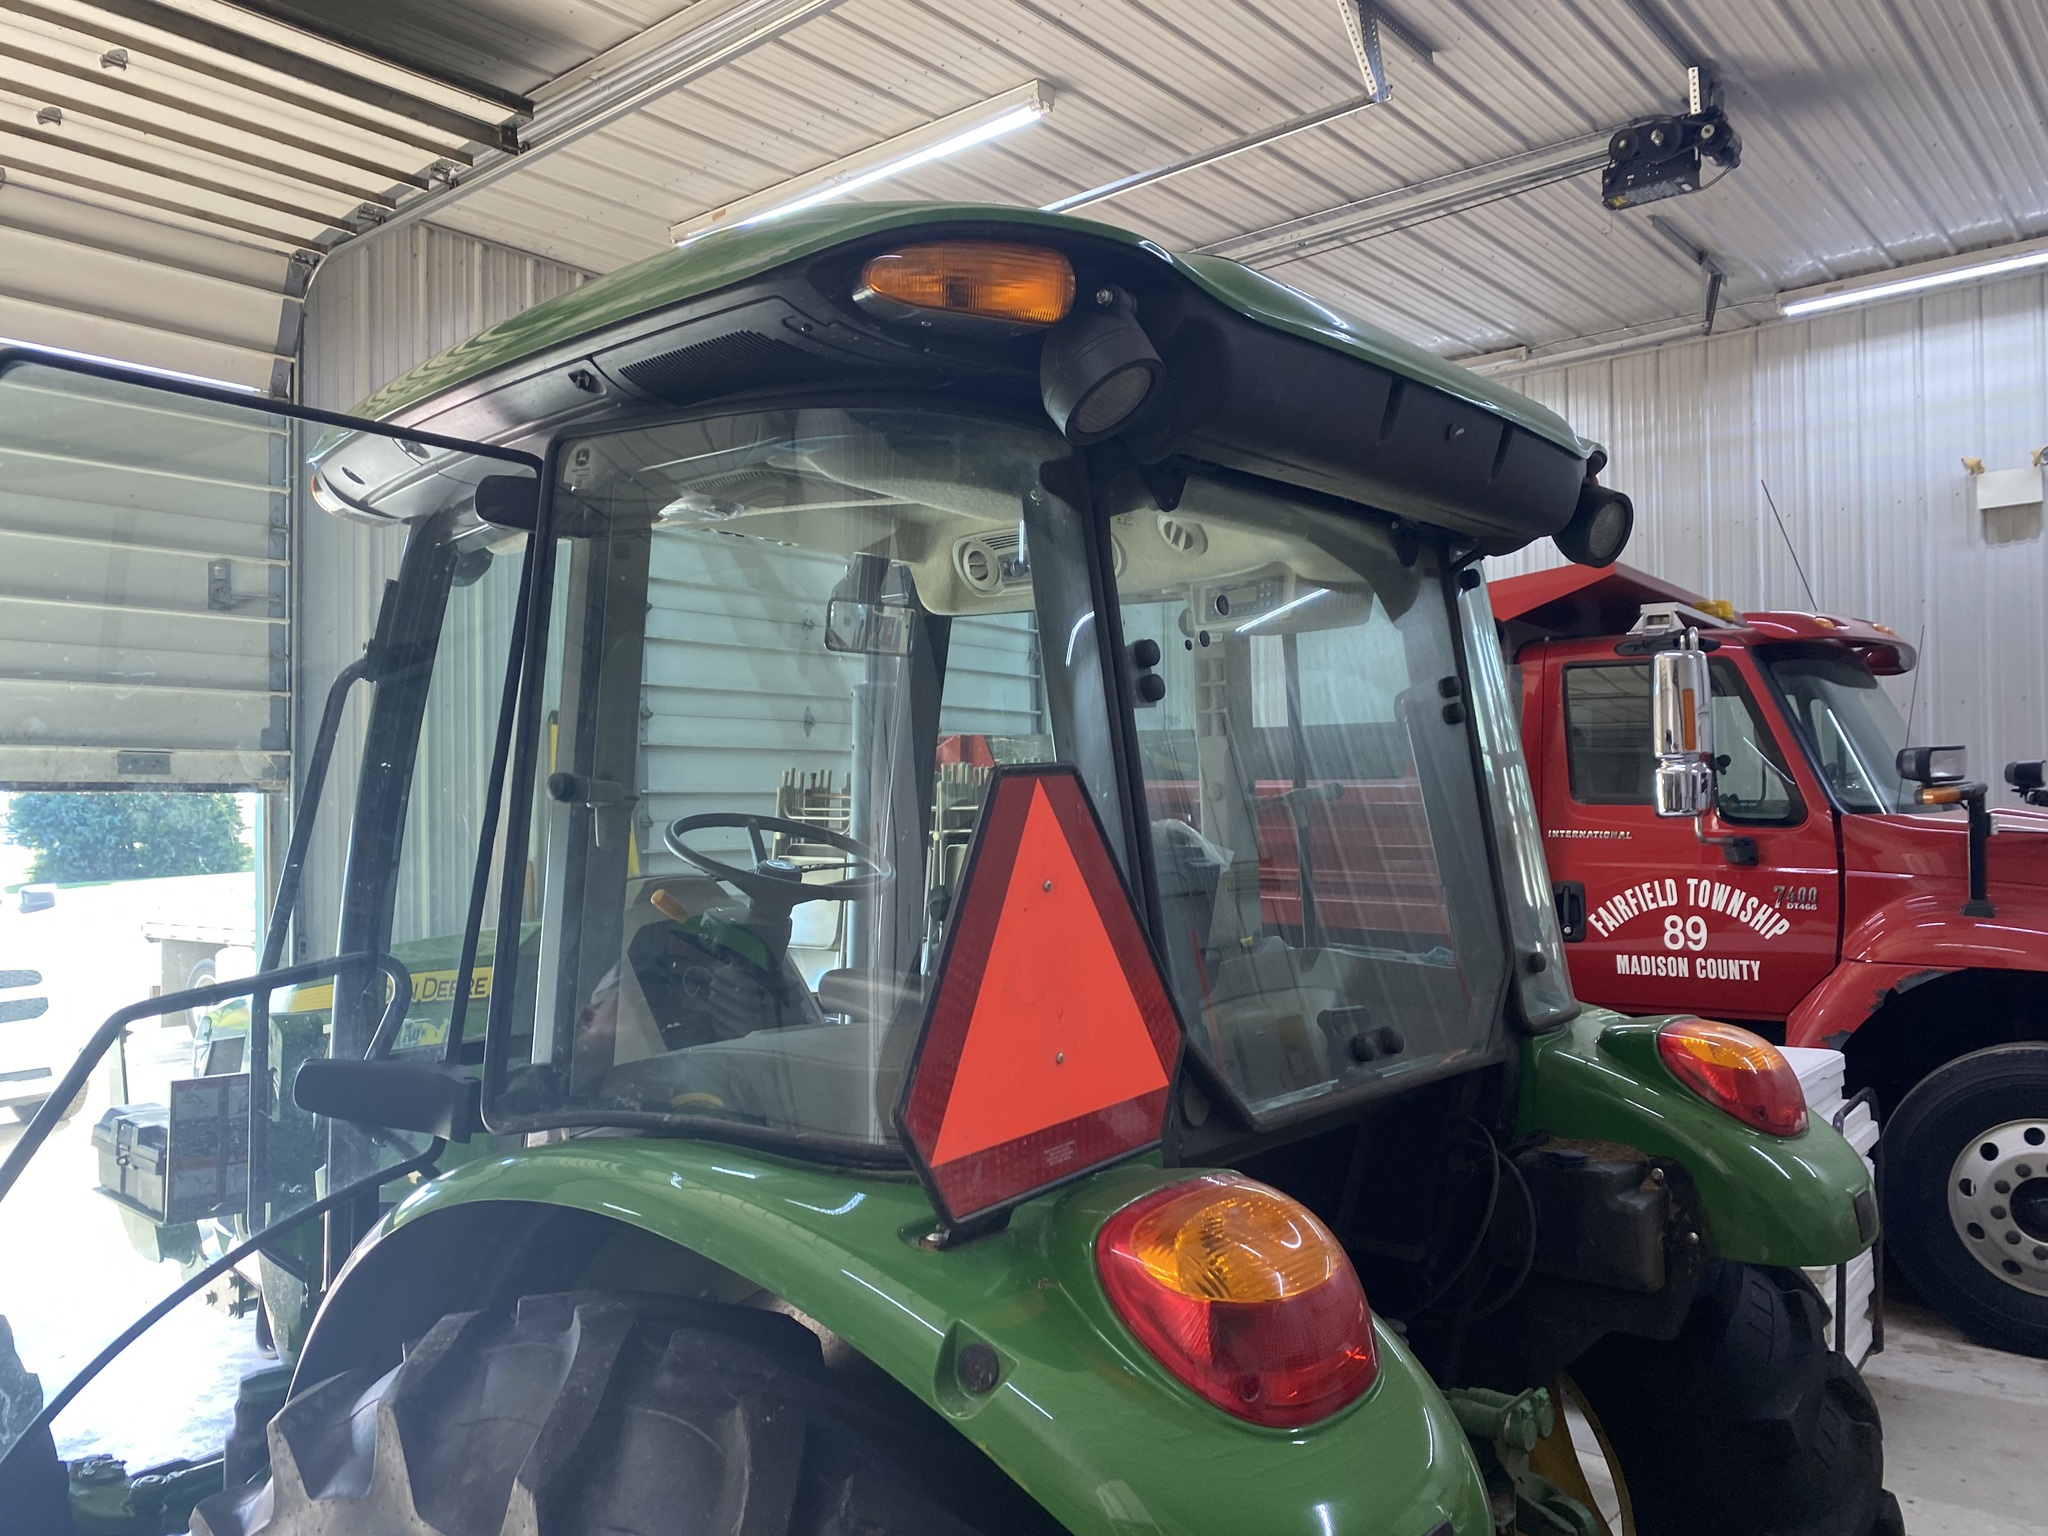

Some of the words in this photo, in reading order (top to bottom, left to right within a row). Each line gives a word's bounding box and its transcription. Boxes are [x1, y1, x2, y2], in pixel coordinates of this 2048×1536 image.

[1548, 829, 1632, 840] INTERNATIONAL
[1588, 878, 1678, 938] FAIRFIELD
[1687, 878, 1790, 940] TOWNSHIP
[1773, 885, 1817, 909] 7400
[1664, 915, 1707, 951] 89
[1616, 954, 1689, 977] MADISON
[1696, 957, 1760, 981] COUNTY
